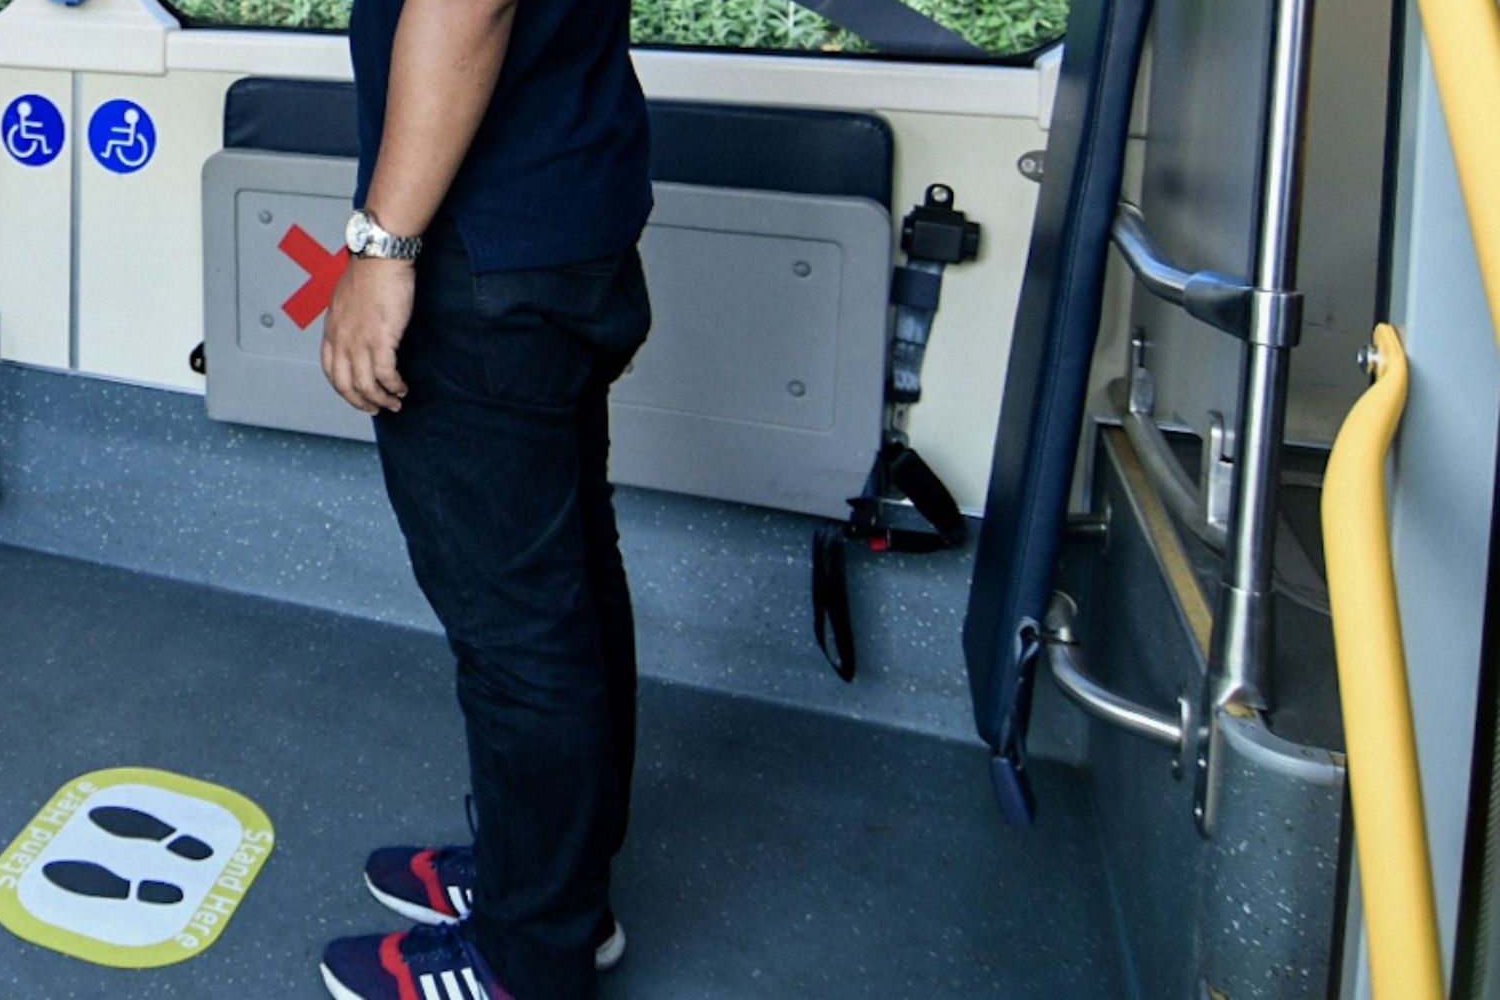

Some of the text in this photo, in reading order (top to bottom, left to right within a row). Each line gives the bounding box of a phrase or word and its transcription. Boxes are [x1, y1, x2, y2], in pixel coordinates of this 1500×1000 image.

[39, 780, 100, 837] Here
[174, 827, 275, 949] Stand Here
